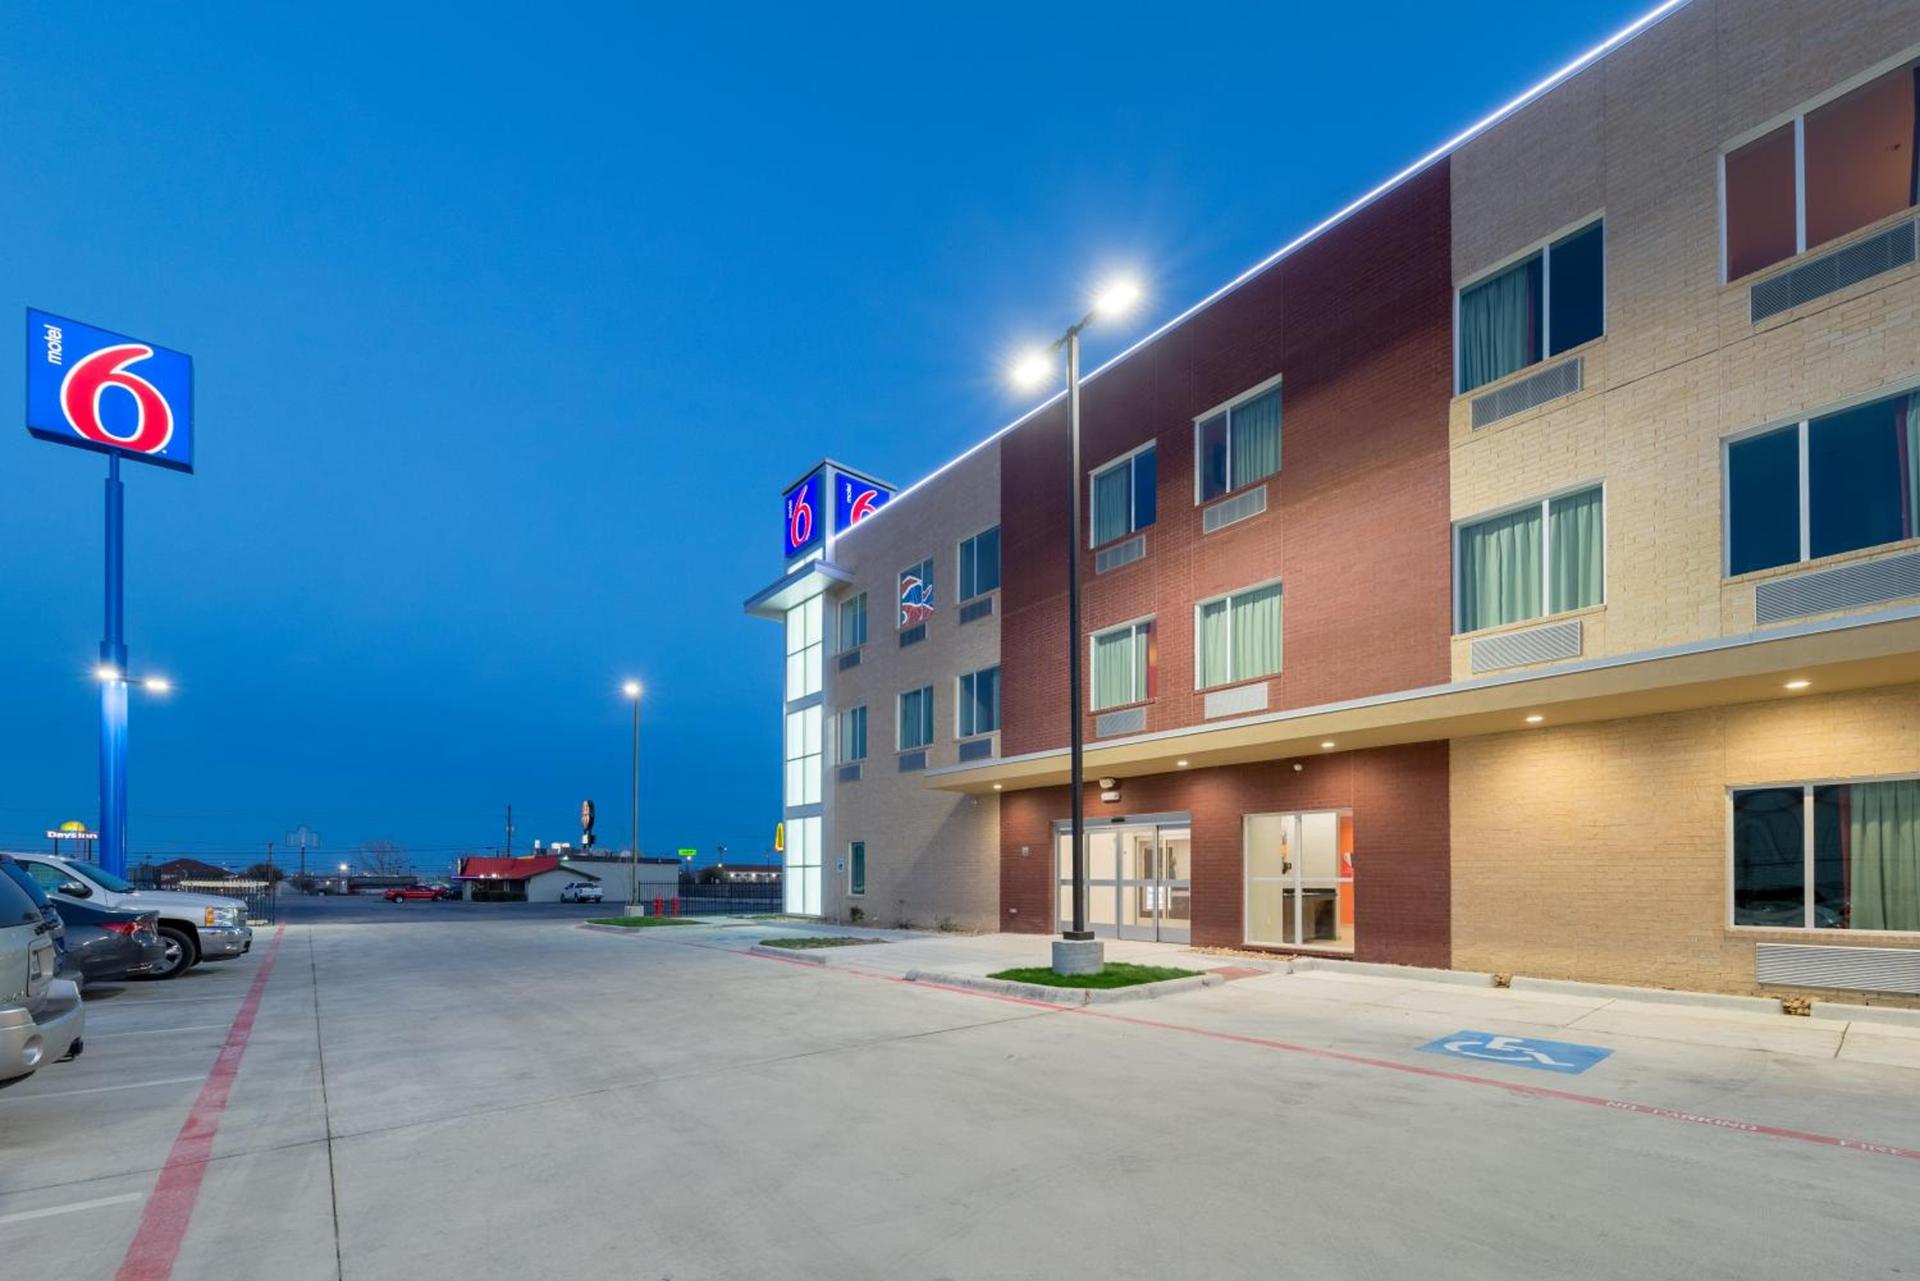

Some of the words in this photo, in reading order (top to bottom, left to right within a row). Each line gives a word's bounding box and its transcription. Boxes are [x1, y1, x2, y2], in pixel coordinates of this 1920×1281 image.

[43, 324, 62, 365] motel
[60, 343, 174, 454] 6
[791, 484, 812, 548] 6
[47, 830, 77, 839] Days
